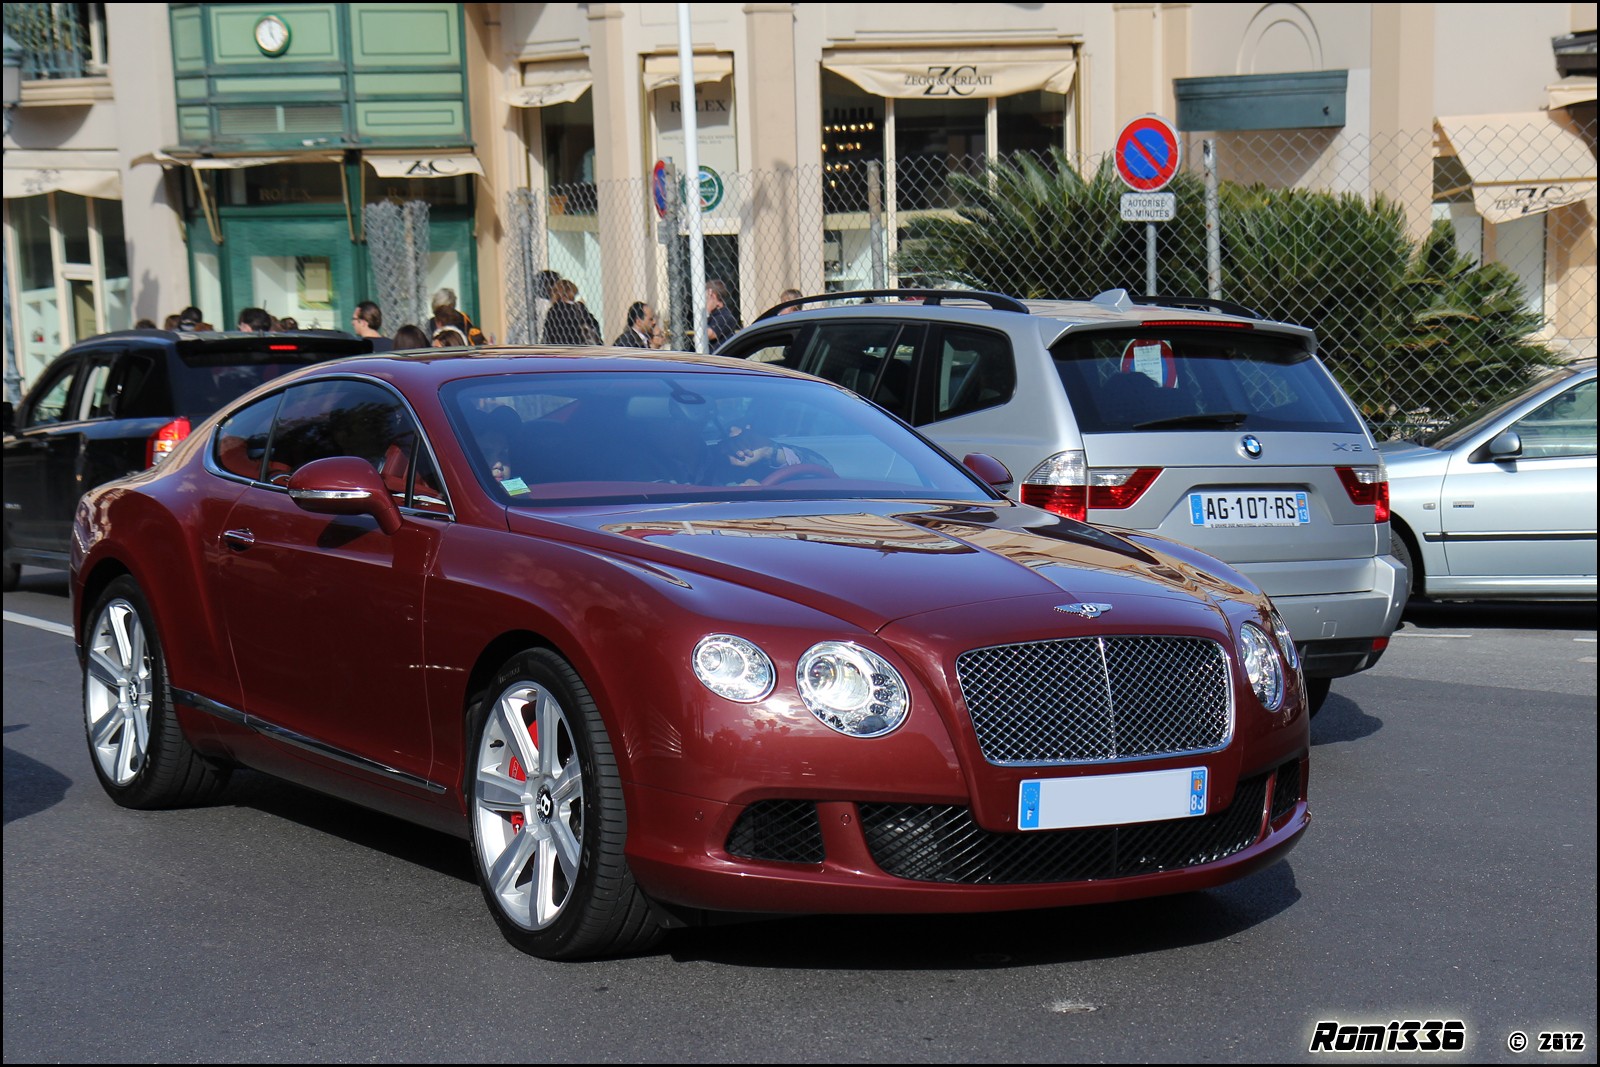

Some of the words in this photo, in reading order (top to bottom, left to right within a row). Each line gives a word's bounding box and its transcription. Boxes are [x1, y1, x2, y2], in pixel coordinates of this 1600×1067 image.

[670, 101, 727, 113] RLEX
[1135, 210, 1170, 218] MINUTES
[1332, 442, 1363, 452] X3
[1299, 509, 1308, 520] 13
[1191, 794, 1204, 811] 83
[1026, 810, 1033, 821] F
